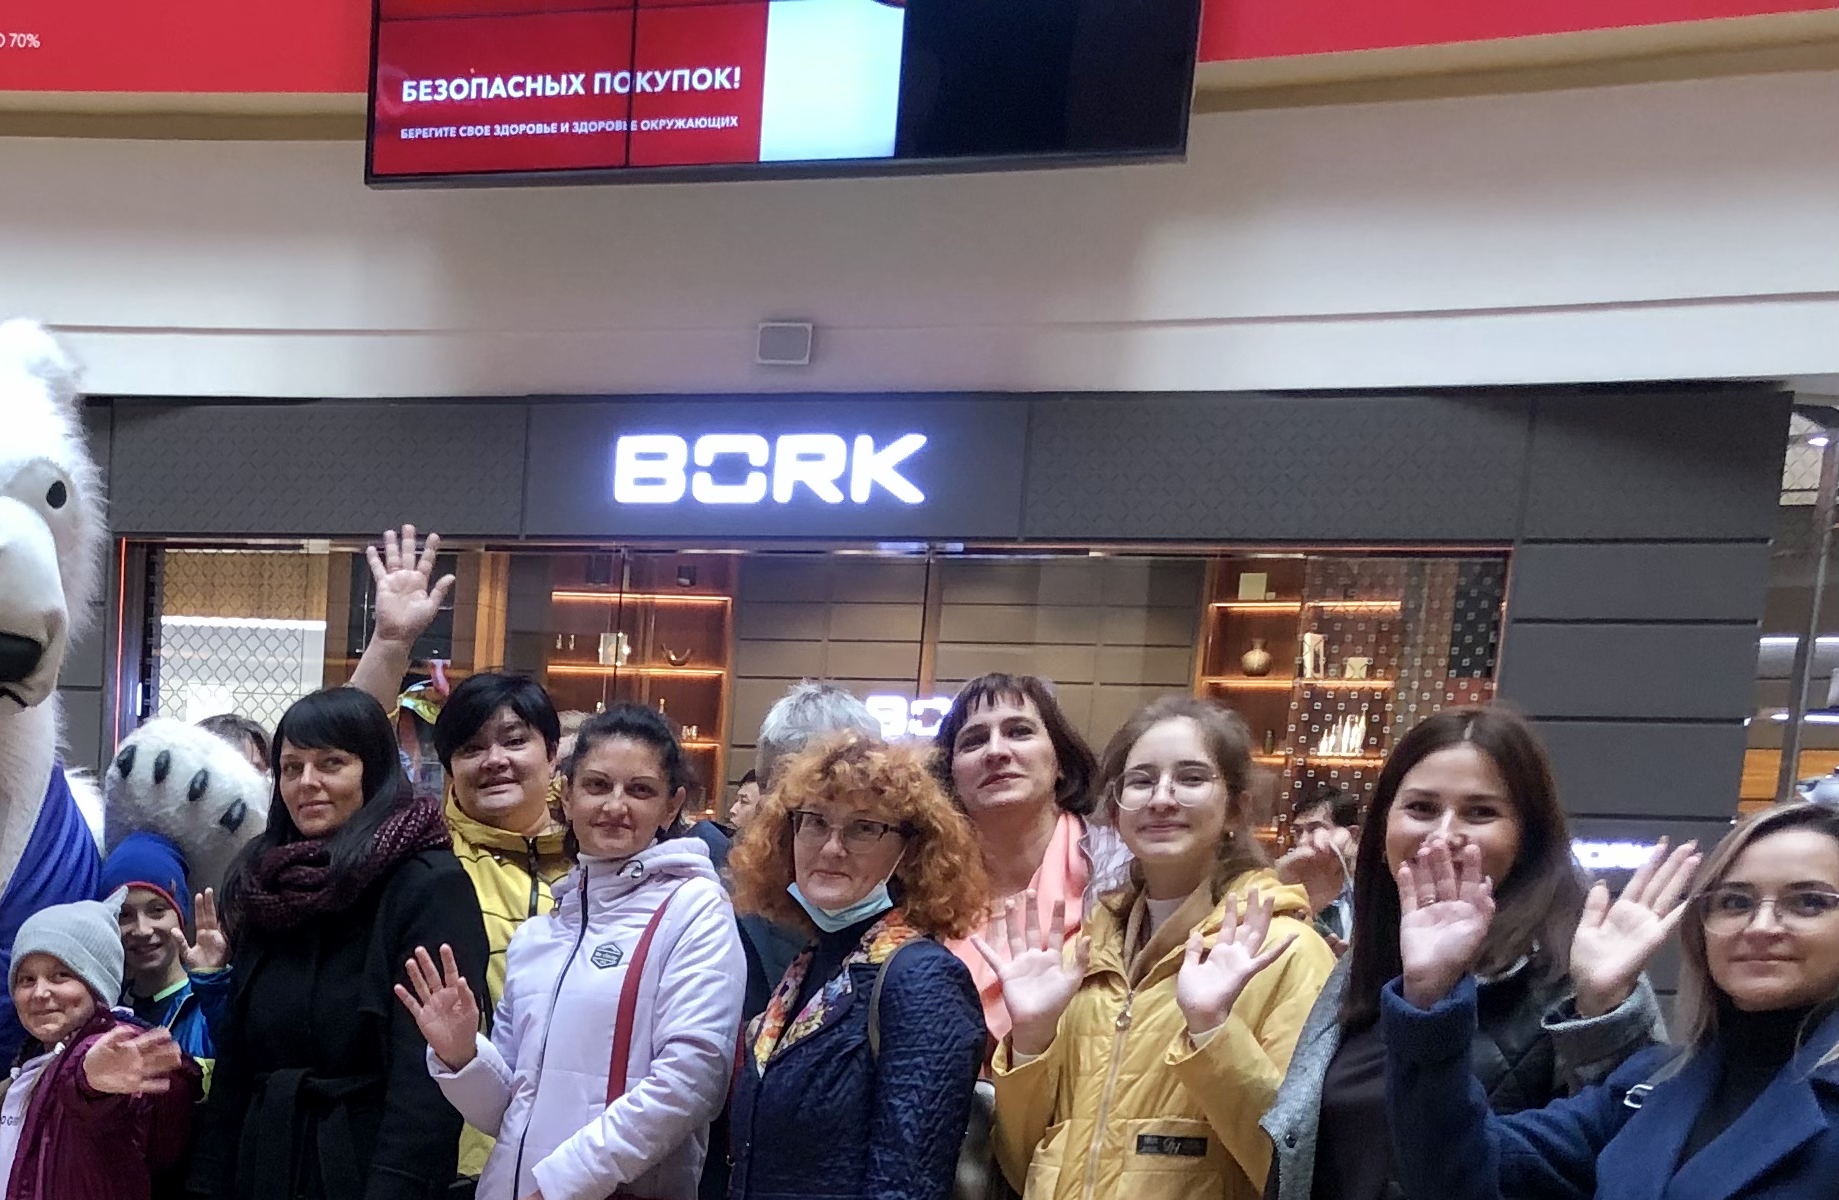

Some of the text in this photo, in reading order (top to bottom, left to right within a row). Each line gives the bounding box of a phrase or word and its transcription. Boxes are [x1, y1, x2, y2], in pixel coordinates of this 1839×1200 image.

[8, 32, 41, 48] 70%
[401, 66, 741, 102] БЕЗОПАСНЫХ ПОКУПОК!
[400, 126, 457, 139] БЕРЕГИТЕ
[458, 124, 491, 137] СВОЕ
[493, 122, 558, 137] ЗДОРОВЬЕ
[560, 121, 569, 133] И
[640, 115, 738, 131] ОКРУЖАЮЩИХ
[614, 433, 927, 504] BORK
